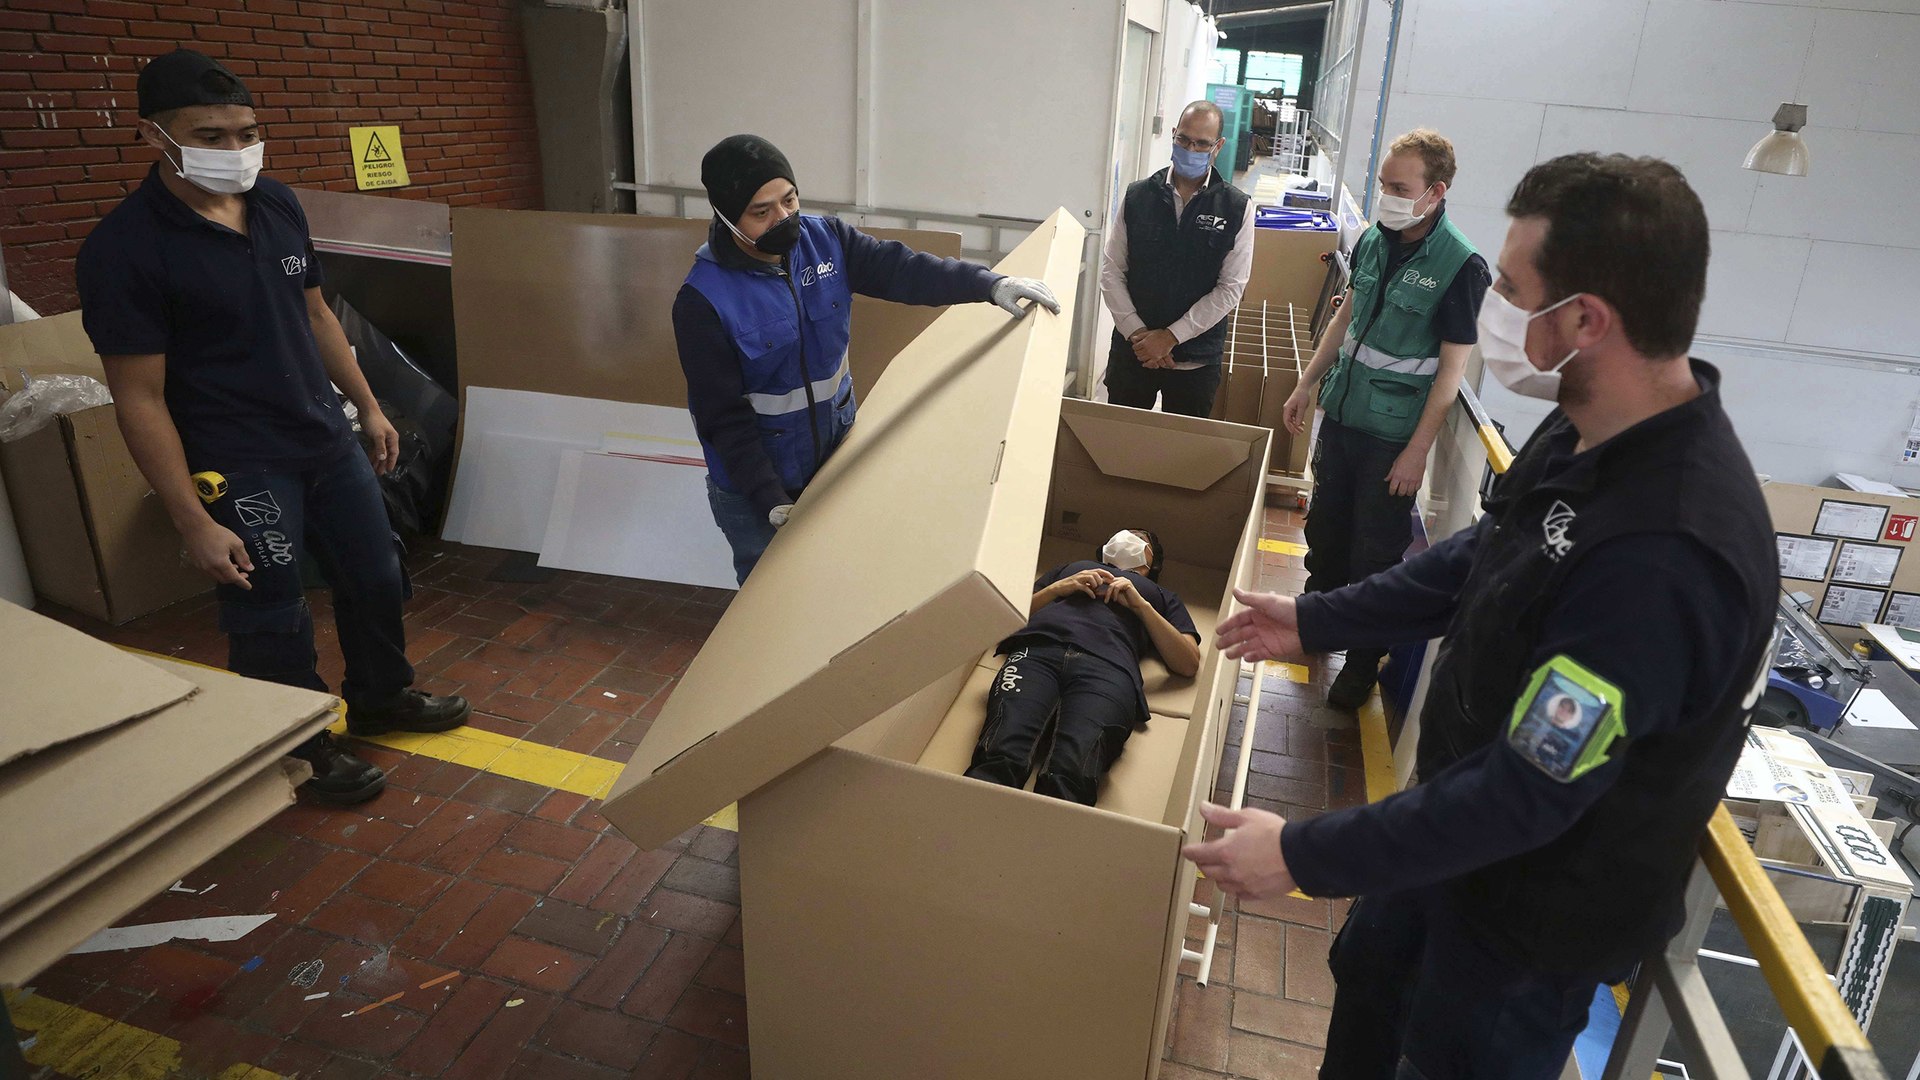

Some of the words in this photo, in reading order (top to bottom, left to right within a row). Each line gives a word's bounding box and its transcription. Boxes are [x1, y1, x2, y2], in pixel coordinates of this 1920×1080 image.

[817, 261, 834, 275] abc
[1418, 276, 1437, 289] abc
[251, 532, 271, 568] DISPLAYS
[262, 530, 293, 566] abc
[1001, 665, 1023, 692] abc
